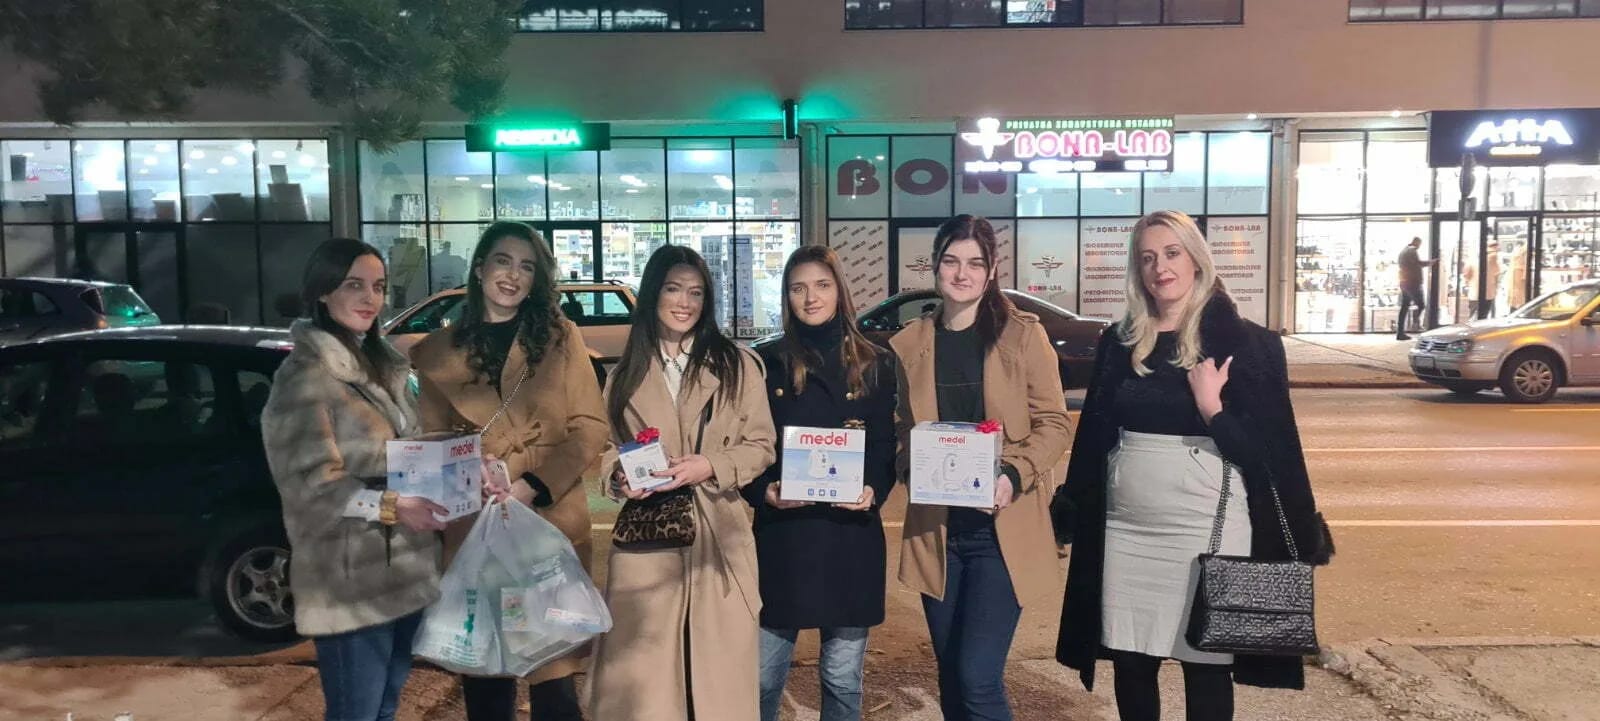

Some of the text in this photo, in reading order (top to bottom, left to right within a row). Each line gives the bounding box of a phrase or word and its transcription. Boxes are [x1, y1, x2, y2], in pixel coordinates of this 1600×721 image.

[1014, 130, 1172, 157] BONA-LAB
[799, 431, 848, 447] medel
[938, 435, 966, 444] medel
[450, 439, 475, 458] medel
